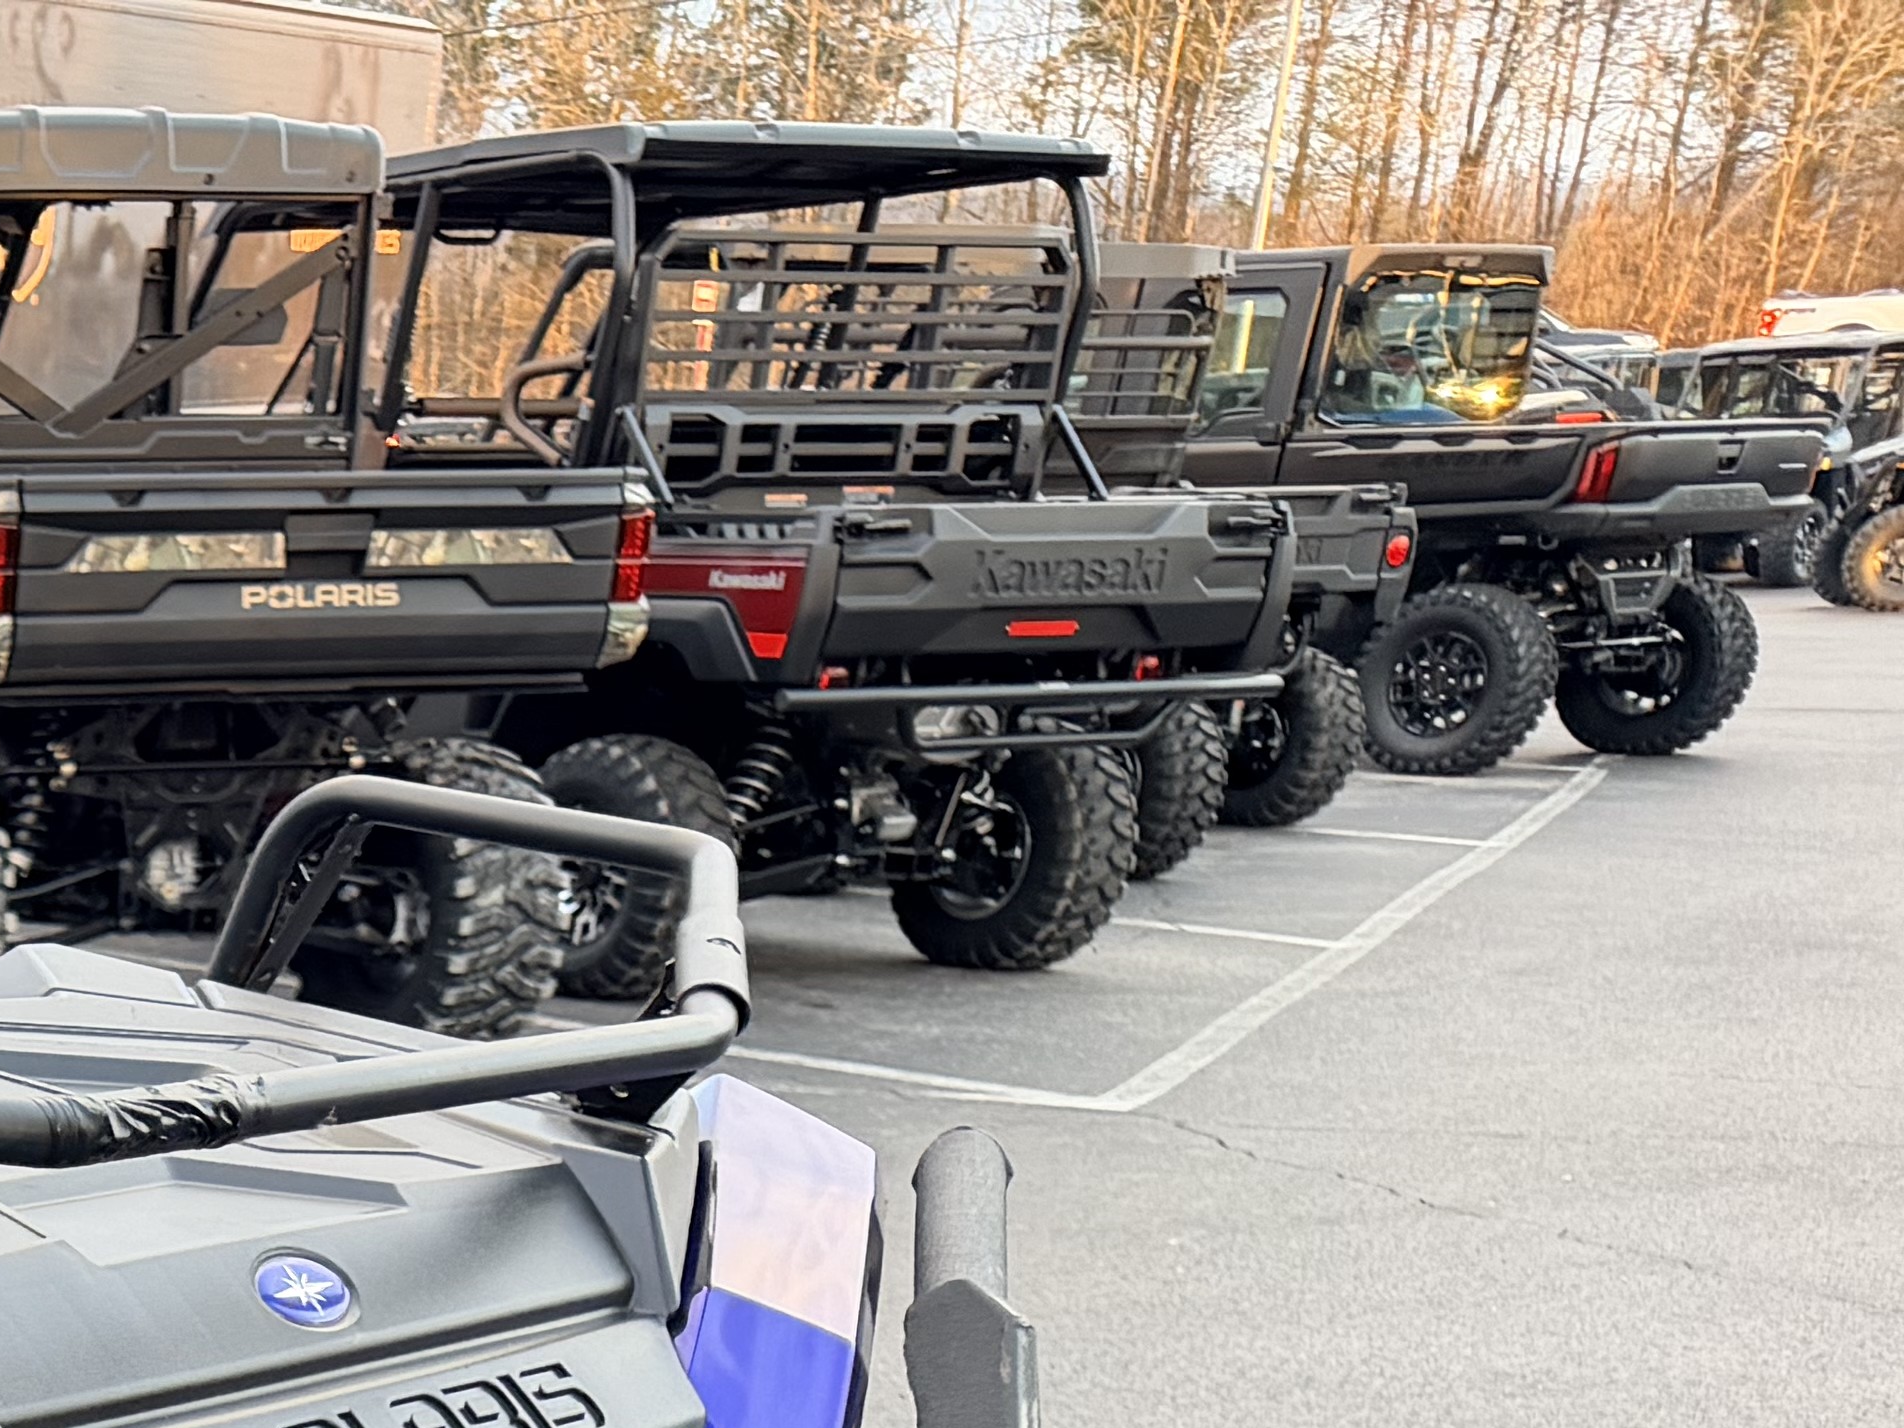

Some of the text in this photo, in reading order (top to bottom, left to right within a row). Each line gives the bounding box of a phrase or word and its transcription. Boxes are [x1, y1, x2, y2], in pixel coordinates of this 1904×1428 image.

[708, 569, 787, 591] Kawasaki
[969, 547, 1169, 598] Kawasaki
[240, 583, 401, 610] POLARIS
